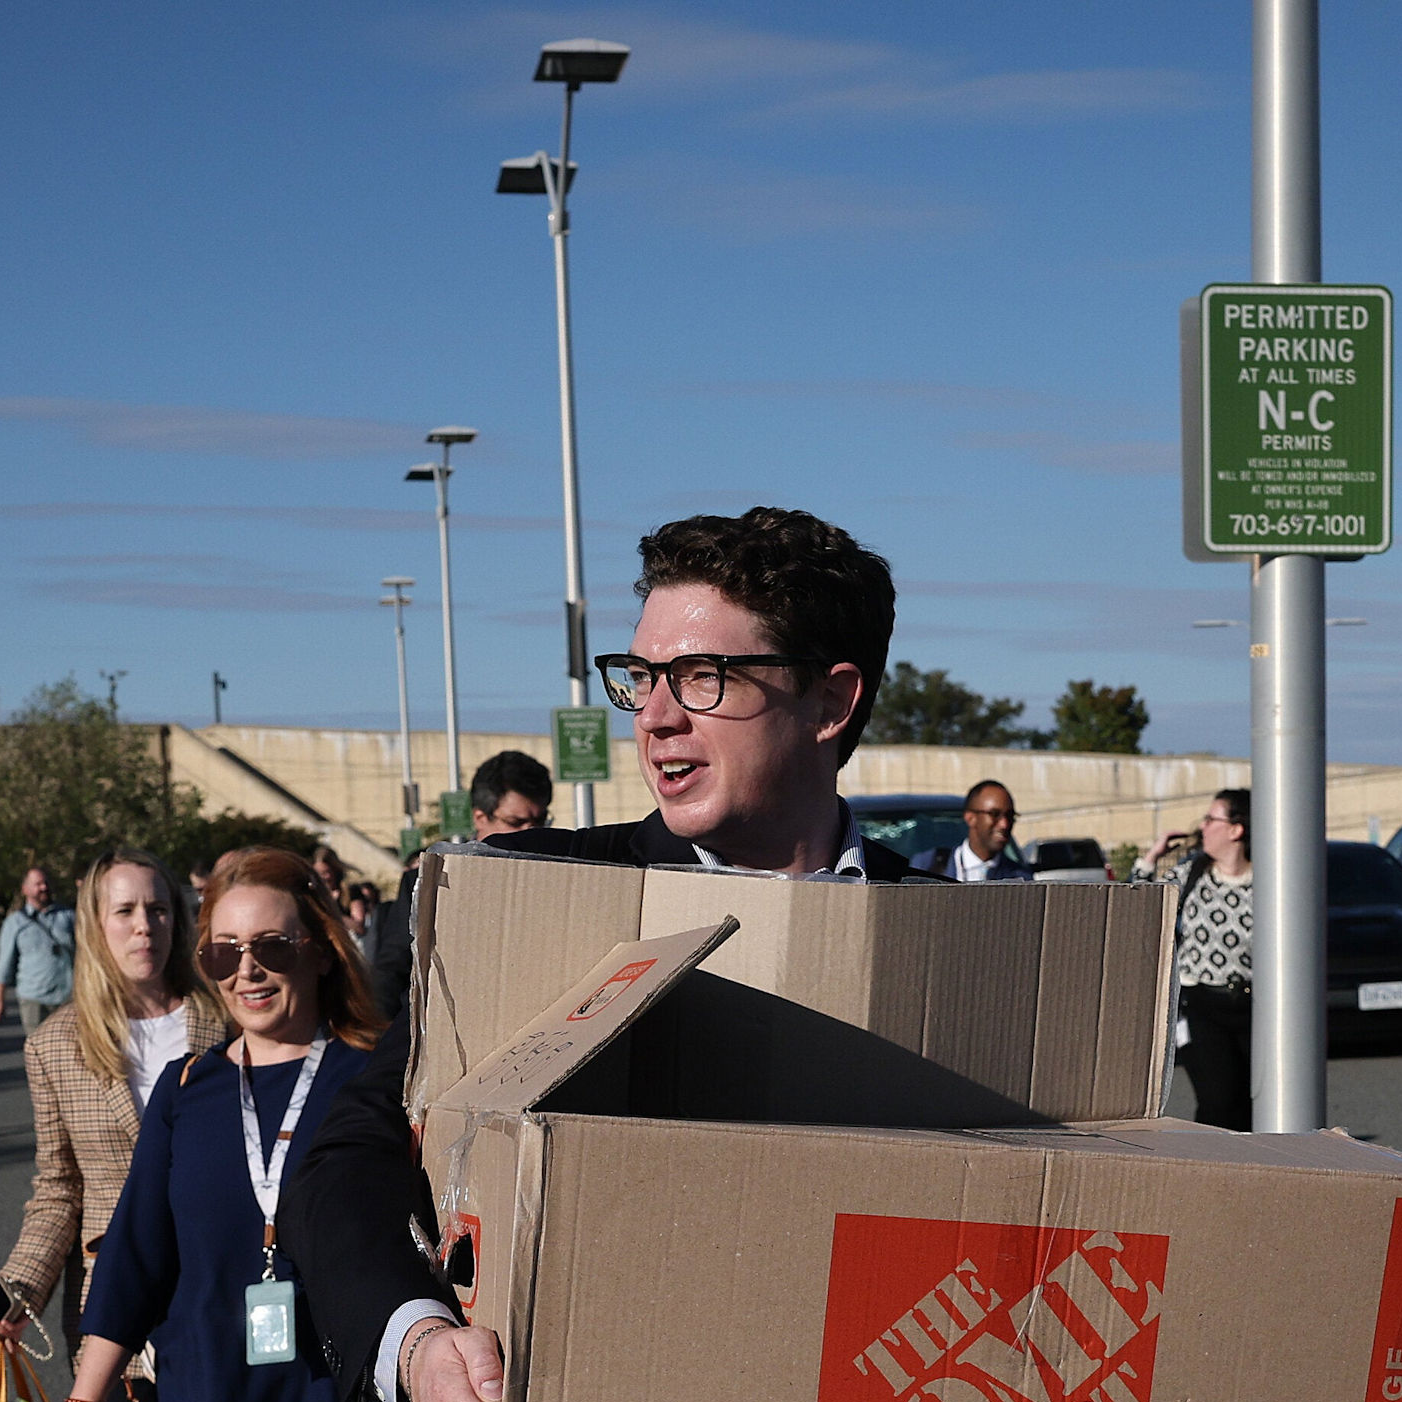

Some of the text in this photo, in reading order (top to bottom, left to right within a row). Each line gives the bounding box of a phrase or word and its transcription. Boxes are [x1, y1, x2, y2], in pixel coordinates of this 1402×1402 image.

[1224, 304, 1369, 330] PERMITTED
[1239, 336, 1355, 363] PARKING
[1238, 367, 1357, 385] AT ALL TIMES
[1258, 389, 1335, 432] N-C
[1261, 434, 1333, 452] PERMITS
[1247, 457, 1348, 469] VEHICLES IN VIOLATION
[1217, 470, 1237, 482] WILL
[1255, 470, 1284, 482] TOWED
[1251, 484, 1261, 496] AT
[1304, 484, 1344, 497] EXPENSE
[1228, 513, 1366, 536] 703-697-1001
[852, 1257, 1003, 1398] THE
